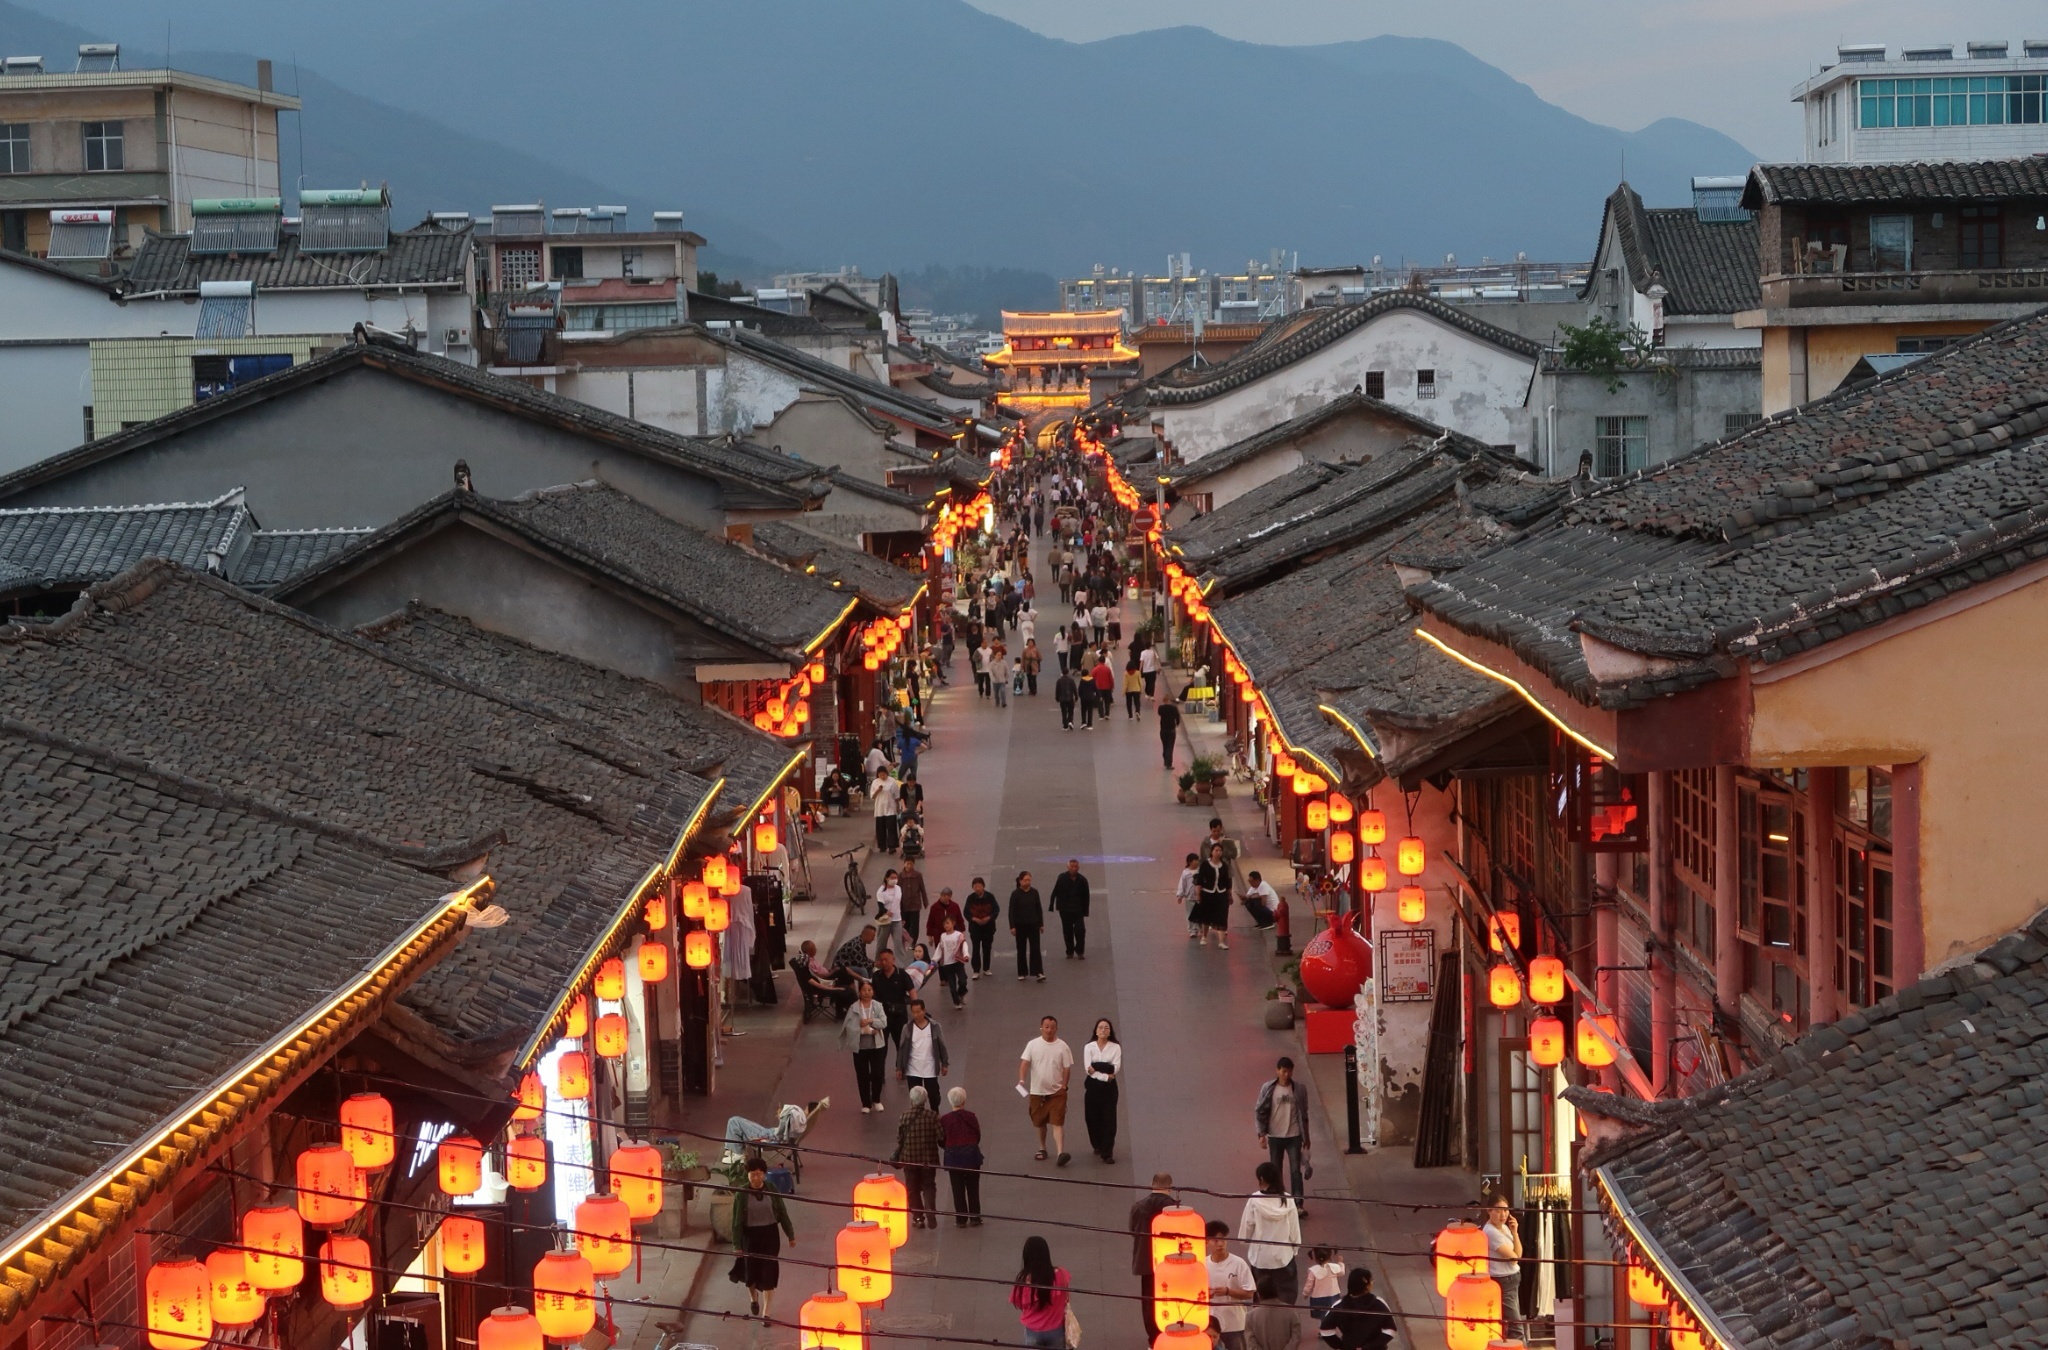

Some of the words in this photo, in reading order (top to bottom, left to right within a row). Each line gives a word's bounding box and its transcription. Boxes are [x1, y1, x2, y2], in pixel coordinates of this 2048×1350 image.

[564, 1115, 585, 1217] 手表维
[859, 1250, 872, 1289] 會理
